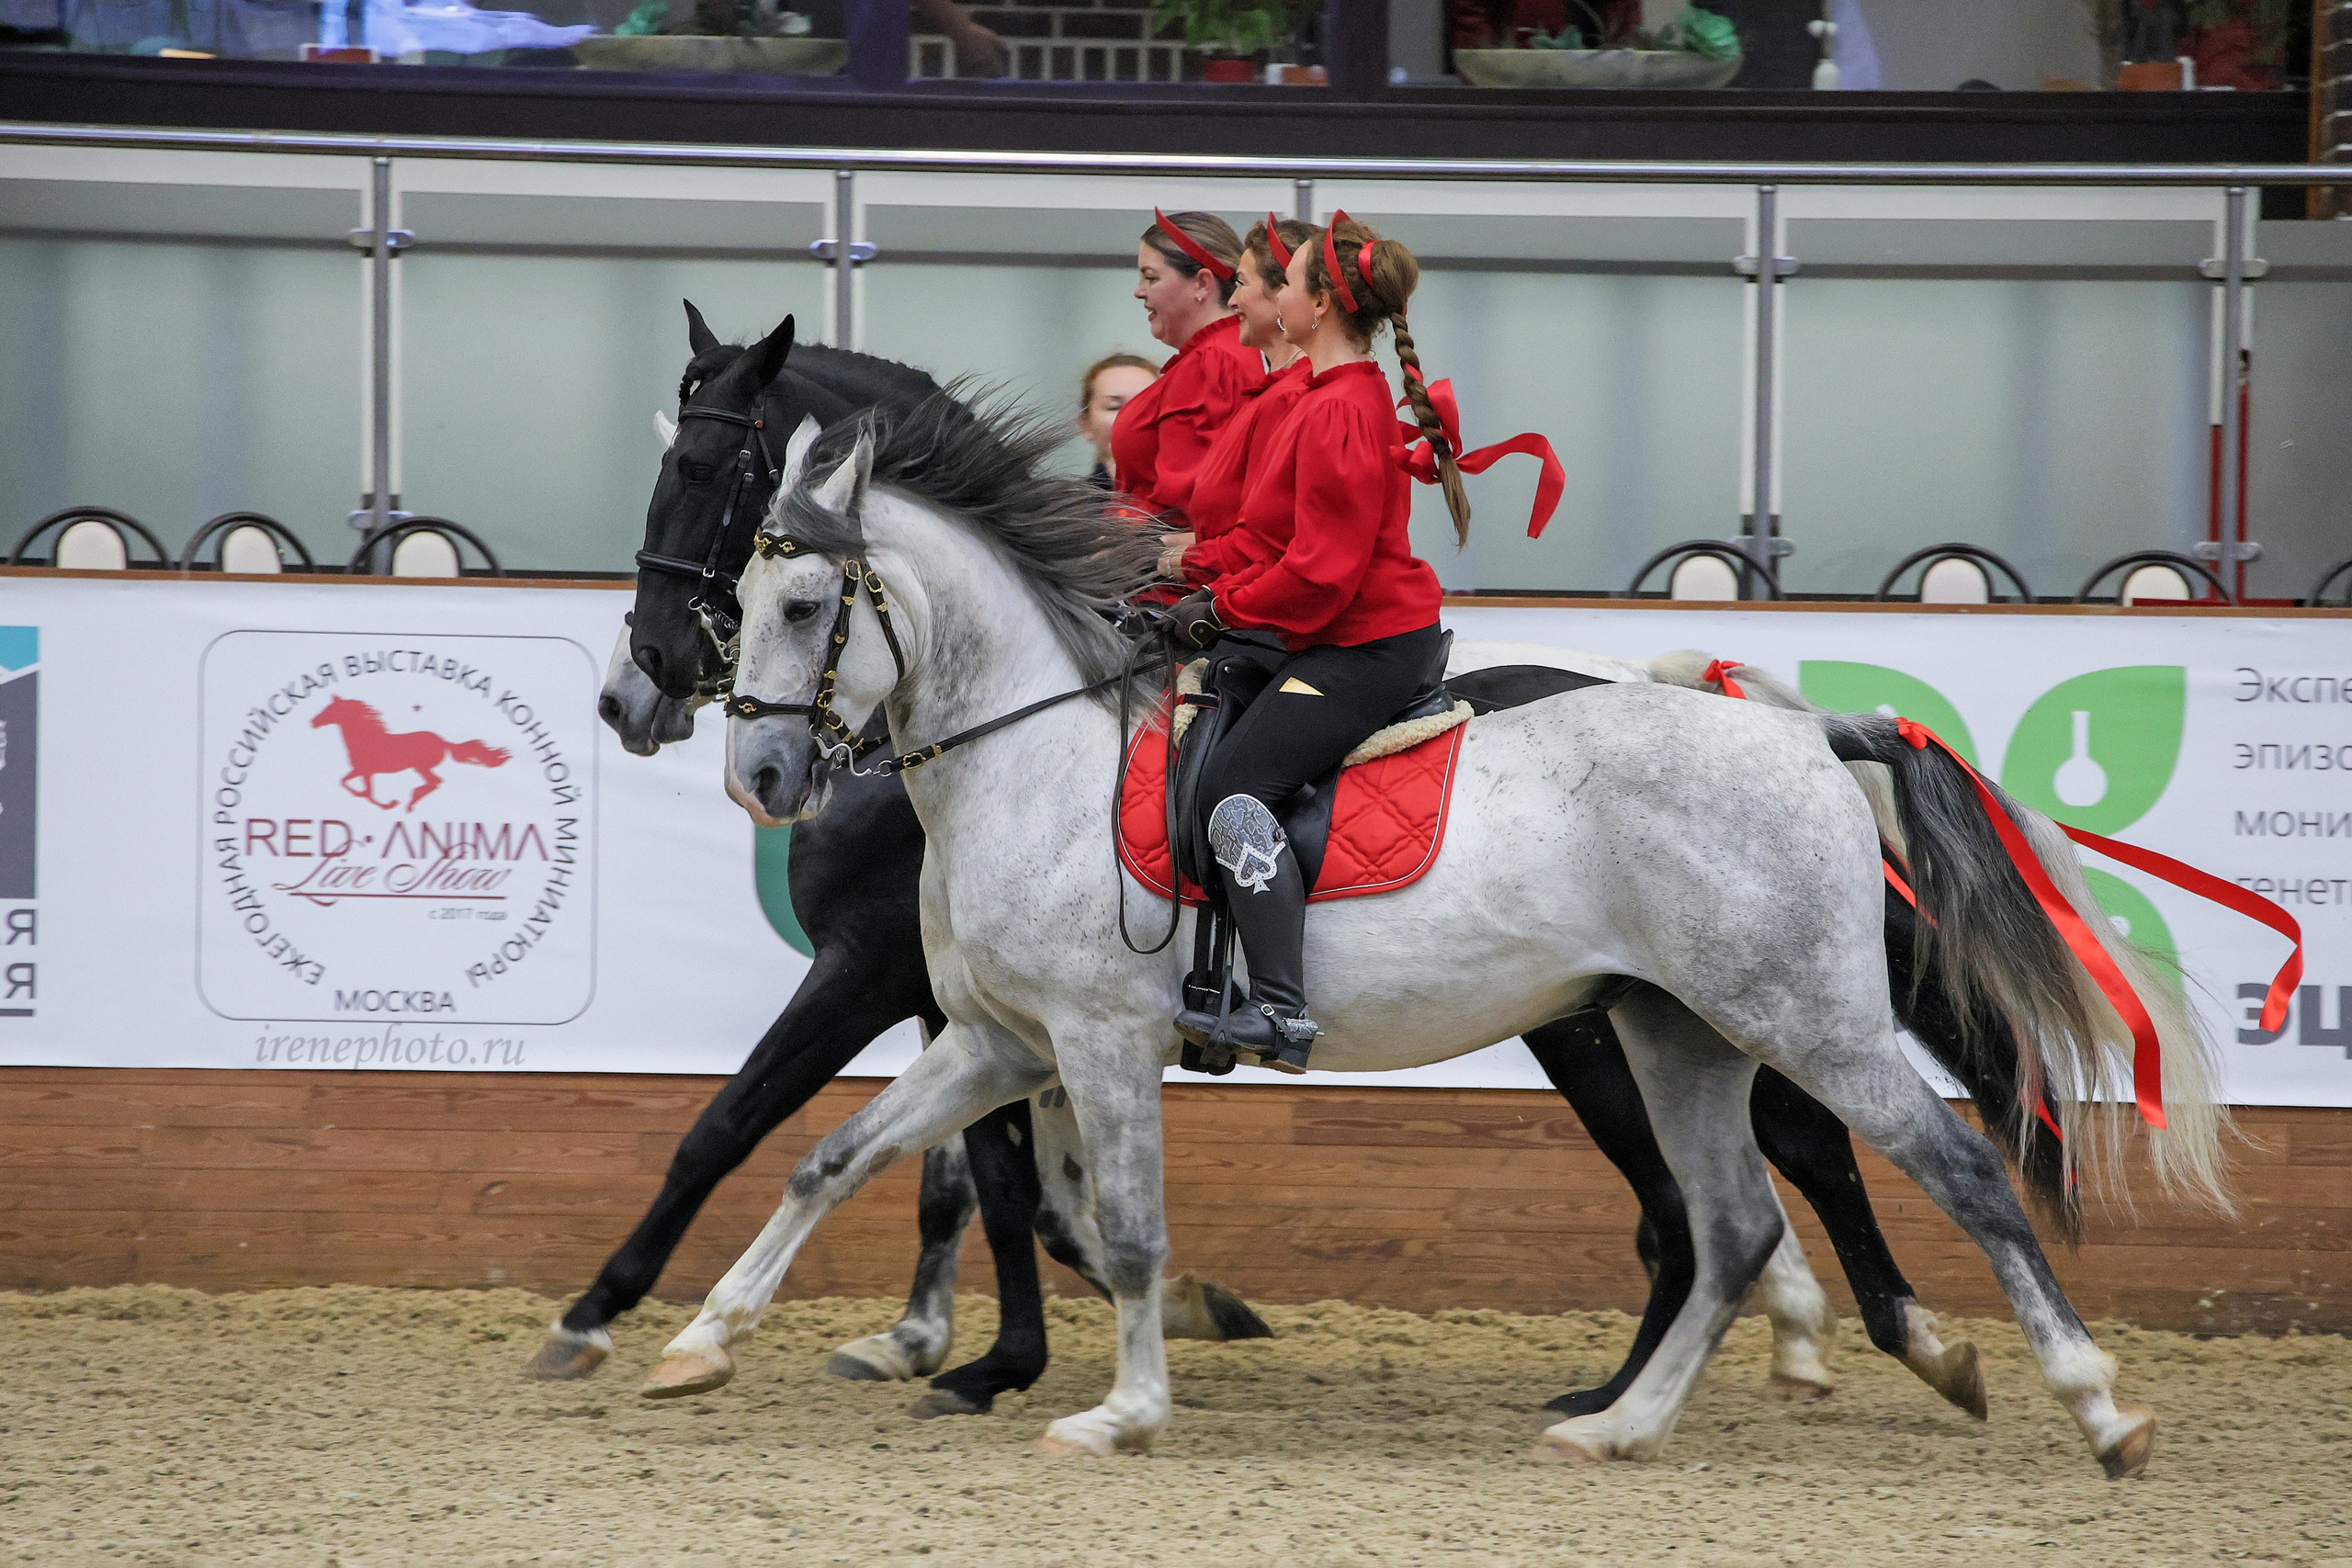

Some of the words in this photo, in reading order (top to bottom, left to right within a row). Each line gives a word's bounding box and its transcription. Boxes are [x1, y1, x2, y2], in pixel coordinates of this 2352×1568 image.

[343, 649, 492, 699] ВЫСТАВКА
[213, 662, 339, 825] РОССИЙСКАЯ
[493, 690, 582, 806] КОННОЙ
[2234, 810, 2352, 838] мони
[271, 840, 378, 907] Live
[384, 842, 512, 894] Show
[464, 818, 579, 989] МИНИАТЮРЫ
[2234, 877, 2352, 906] генет
[213, 837, 326, 986] ЕЖЕГОДНАЯ
[333, 988, 458, 1013] МОСКВА
